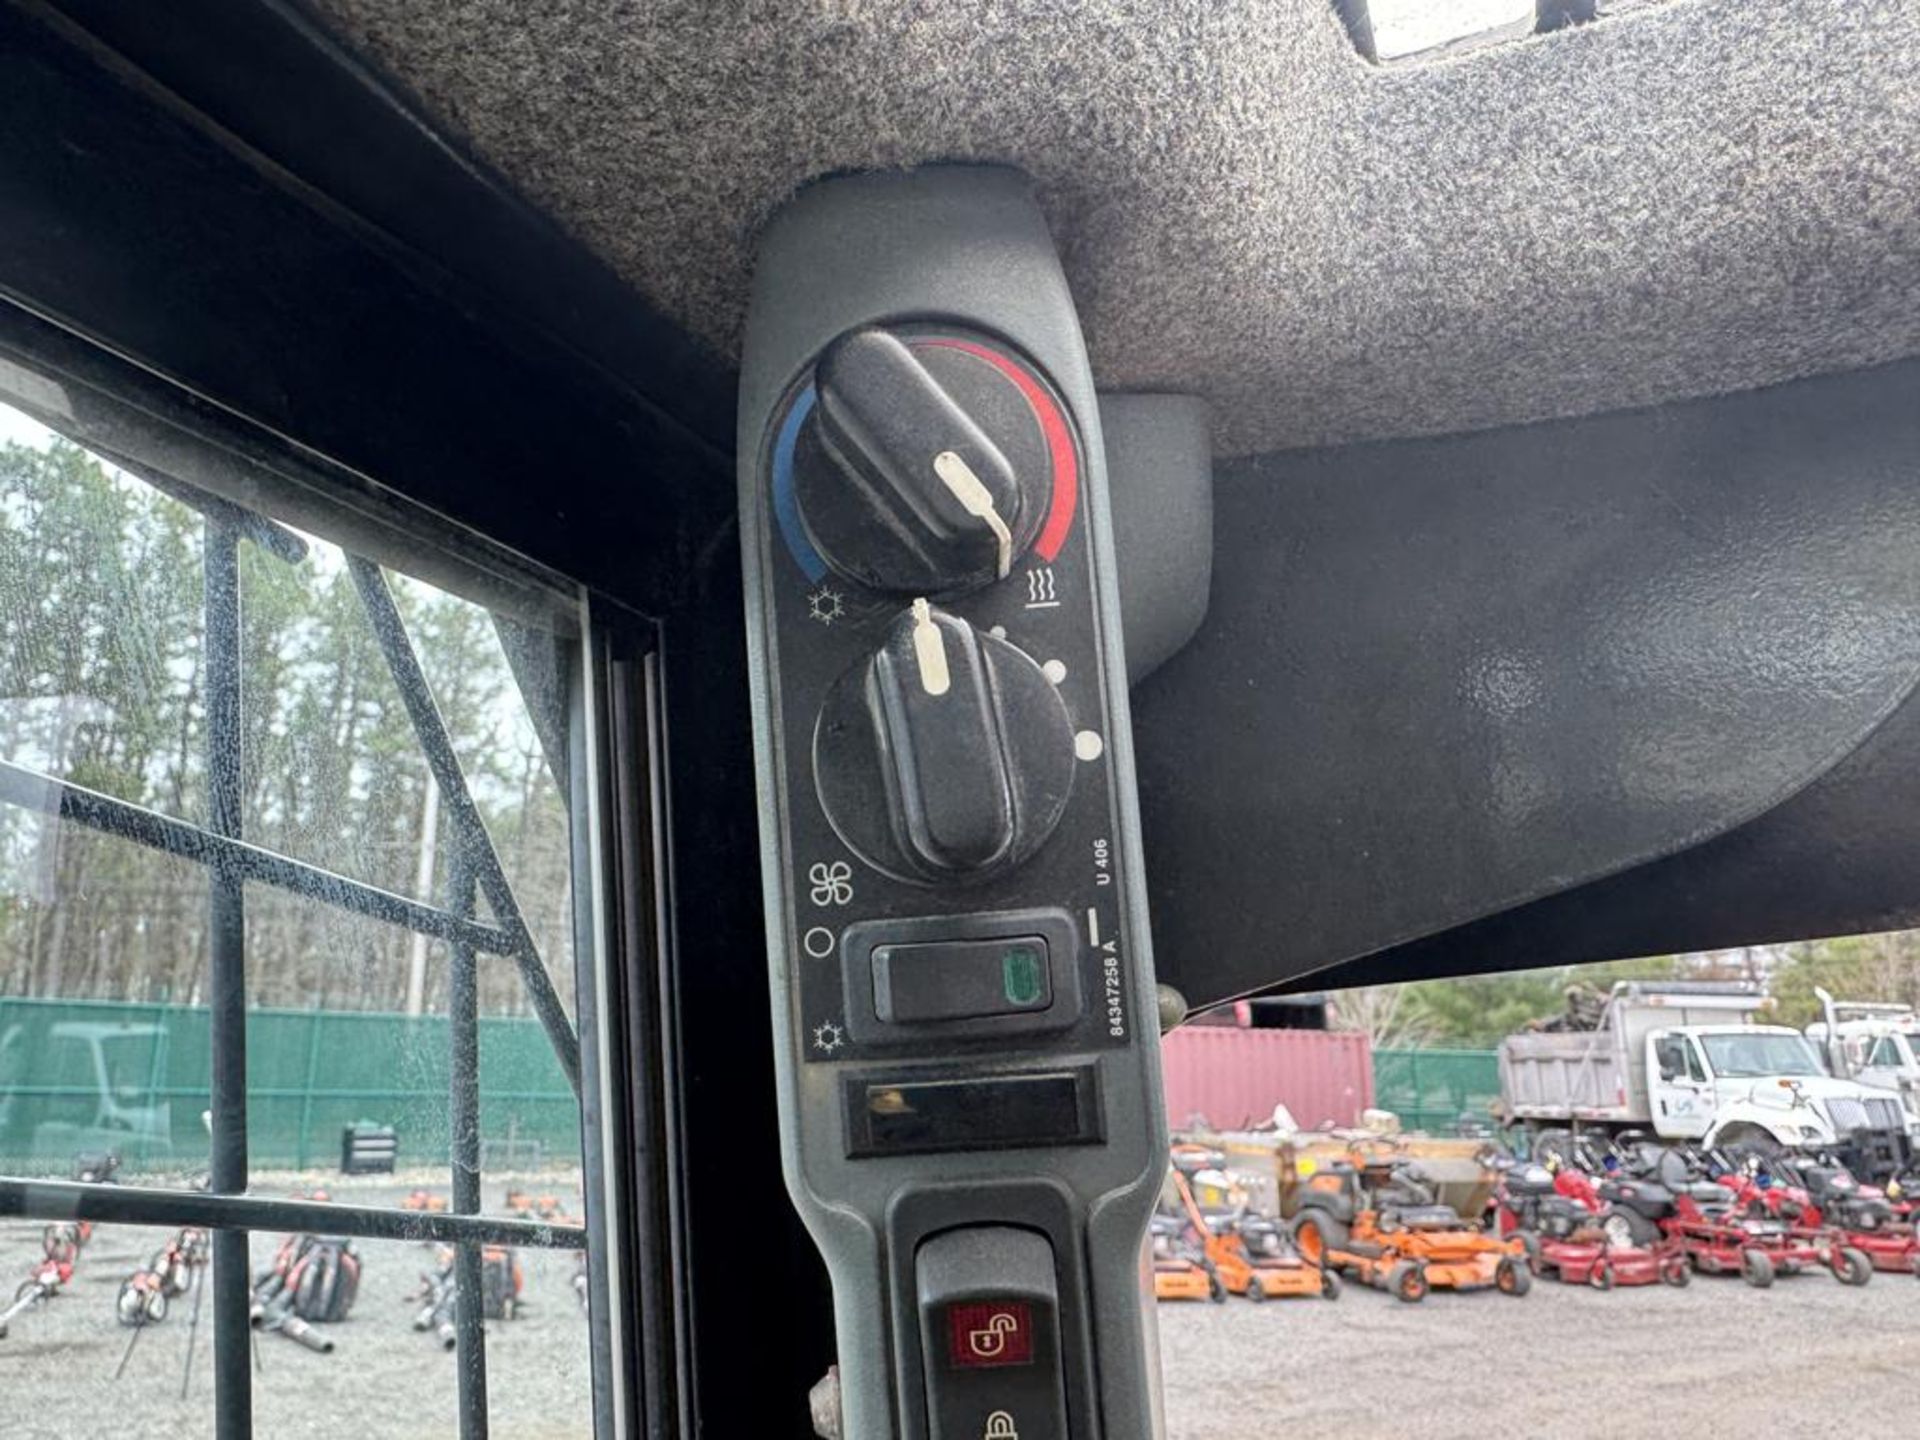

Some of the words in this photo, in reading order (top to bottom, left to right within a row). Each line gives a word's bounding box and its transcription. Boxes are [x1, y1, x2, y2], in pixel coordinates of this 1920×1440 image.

[1094, 838, 1108, 868] 406
[1096, 873, 1111, 886] U
[1102, 940, 1117, 953] A
